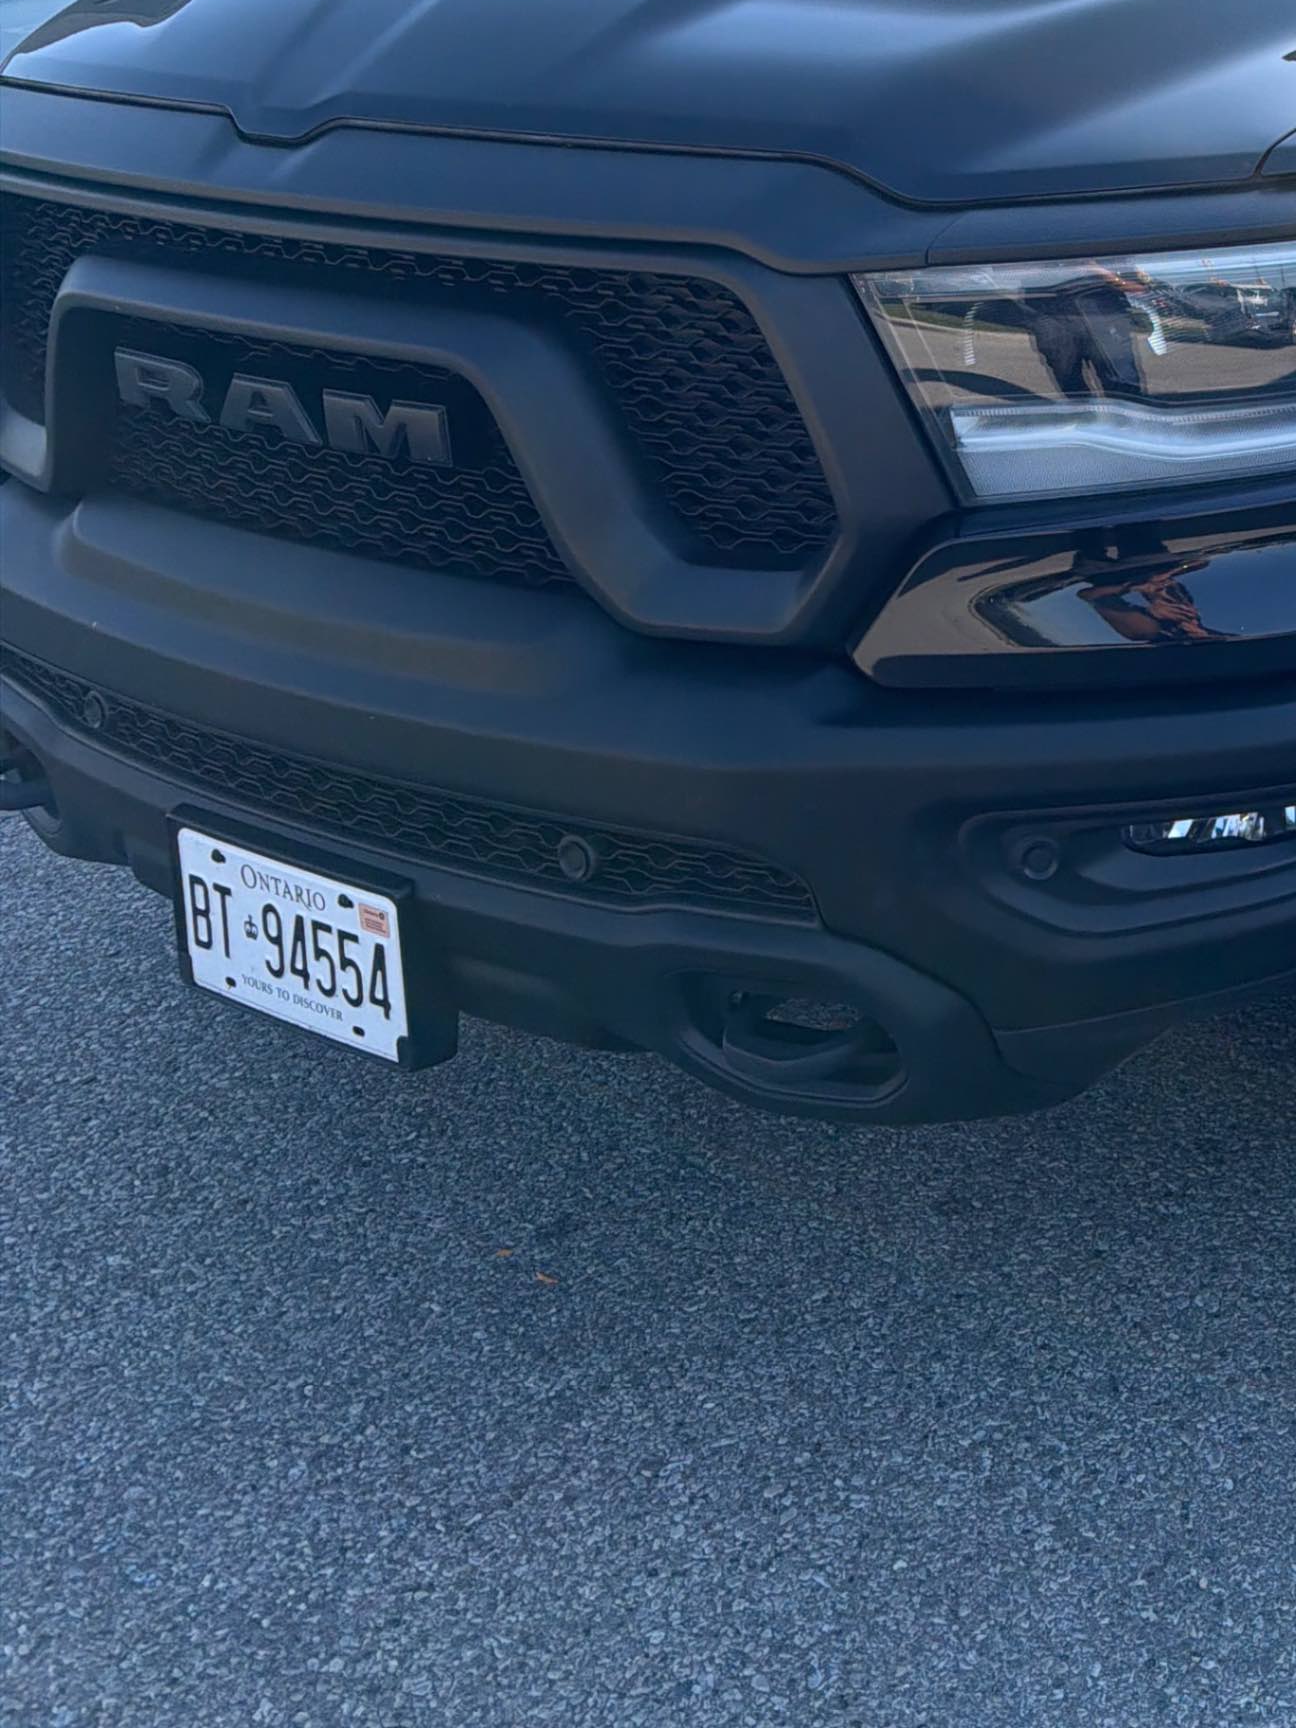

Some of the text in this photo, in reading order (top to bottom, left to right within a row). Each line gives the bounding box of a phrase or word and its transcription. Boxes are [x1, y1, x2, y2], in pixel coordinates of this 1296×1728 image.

[113, 346, 454, 468] RAM
[240, 864, 326, 911] ONTARIO
[188, 874, 392, 1020] BT 94554
[241, 974, 344, 1021] YOURS TO DISCOVER
